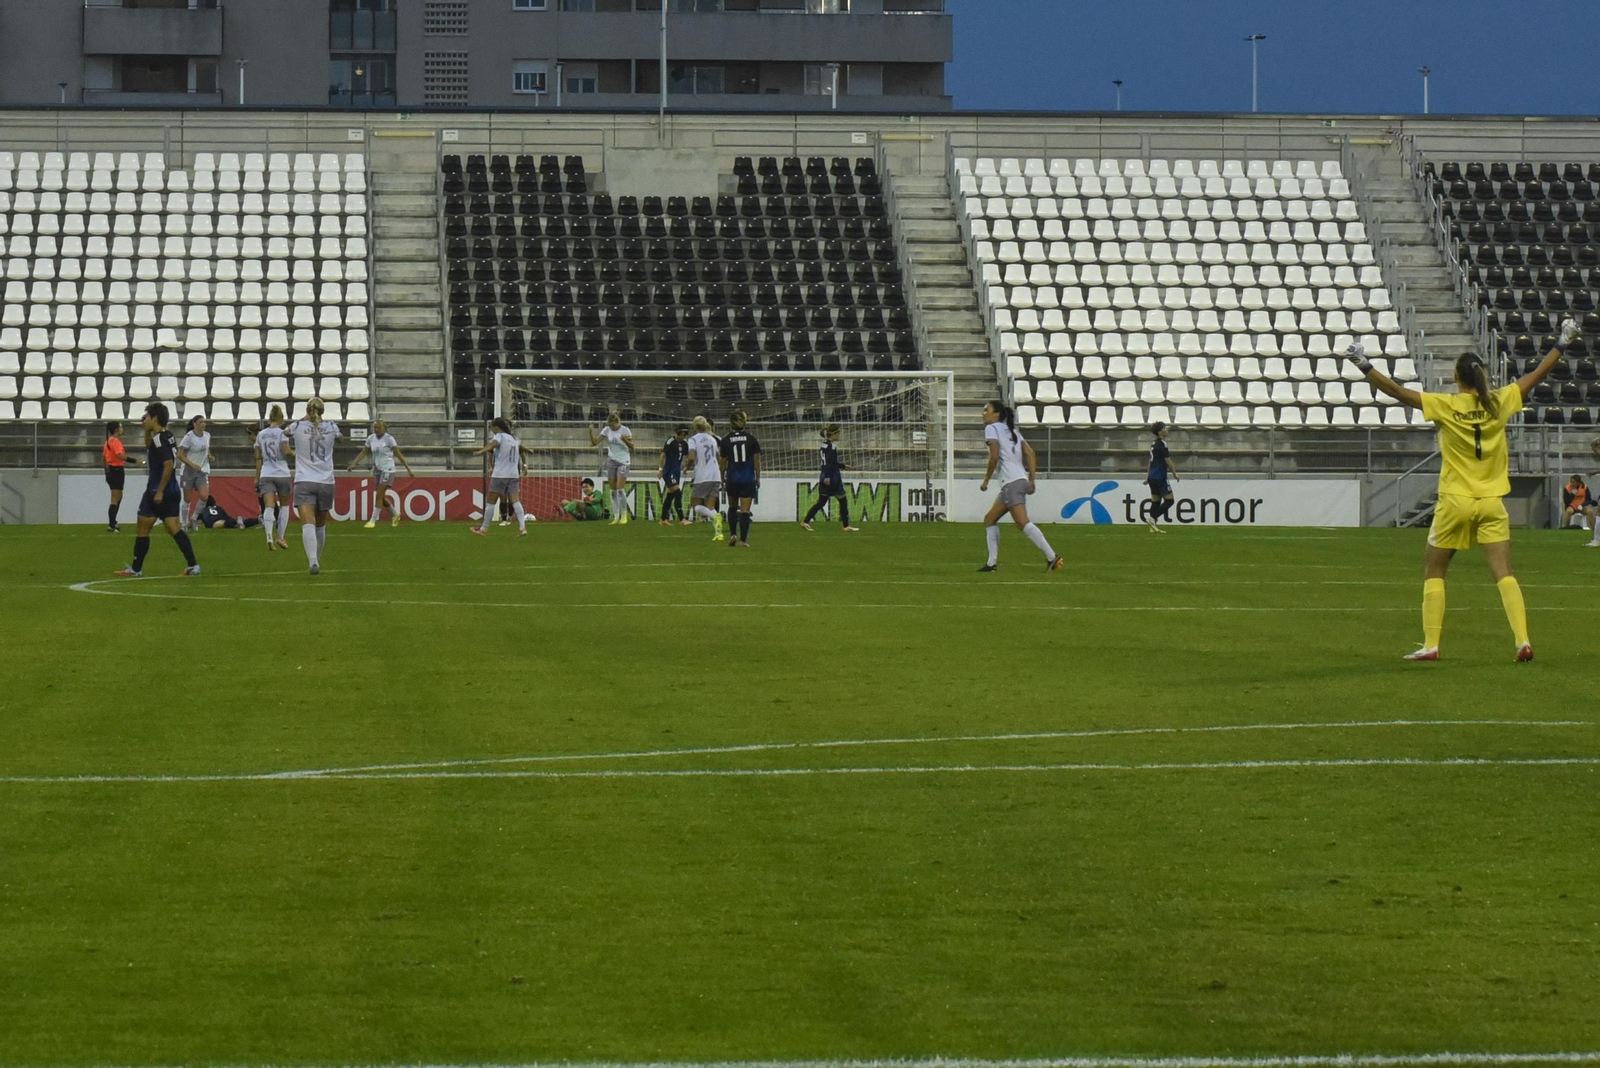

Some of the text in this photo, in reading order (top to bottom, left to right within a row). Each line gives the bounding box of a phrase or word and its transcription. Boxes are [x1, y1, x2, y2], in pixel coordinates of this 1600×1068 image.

[310, 434, 325, 463] 16
[703, 444, 715, 465] 21
[732, 443, 747, 463] 11
[1472, 423, 1482, 461] 1
[209, 507, 219, 517] 6
[293, 478, 460, 522] uinor
[1122, 494, 1264, 523] teenor
